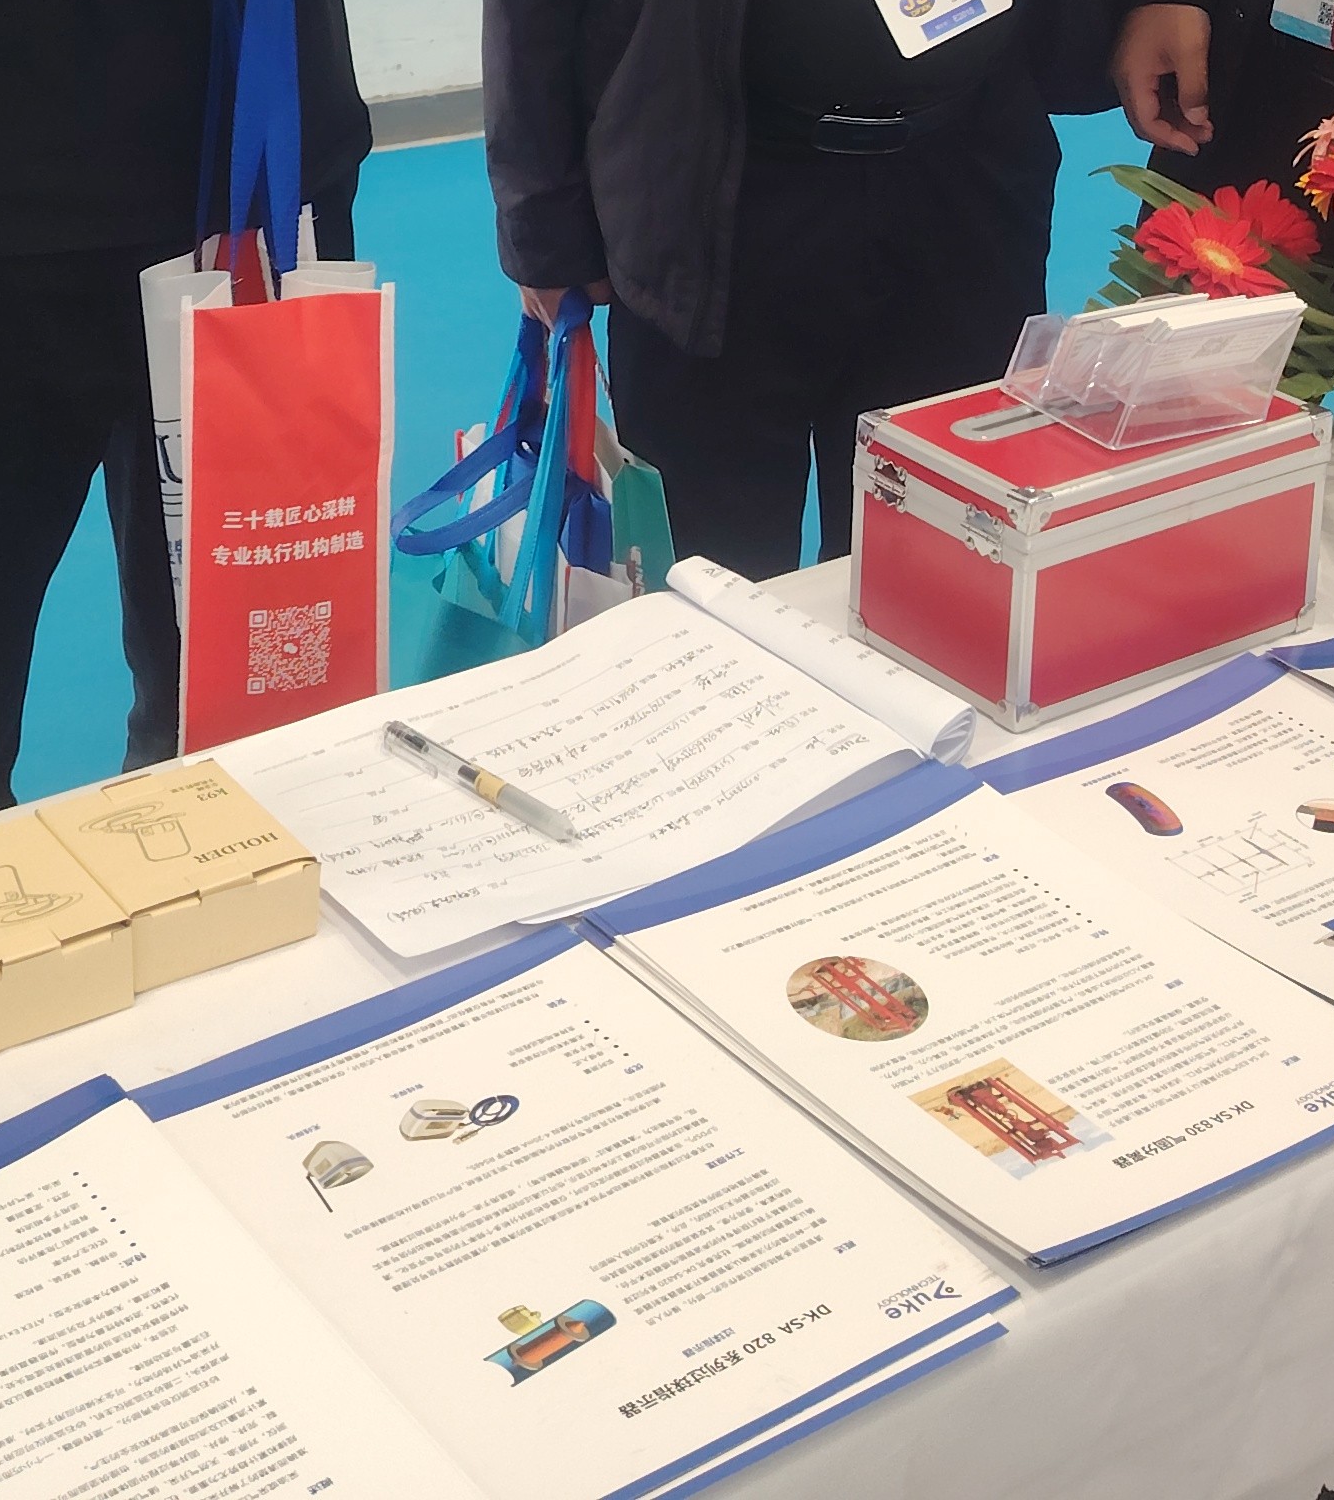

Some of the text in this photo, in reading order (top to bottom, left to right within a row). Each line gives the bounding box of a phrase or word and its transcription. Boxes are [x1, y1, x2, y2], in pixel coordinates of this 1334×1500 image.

[221, 496, 356, 531] 三十载匠心深耕
[210, 530, 365, 567] 专业执行机构制造
[195, 786, 229, 801] k93
[191, 831, 279, 864] HOLDER
[1109, 1100, 1256, 1169] DK SA 830 气固分离器
[704, 1147, 745, 1169] 工作原理
[832, 1239, 857, 1254] 概述
[873, 1272, 941, 1310] TECHNOLOGY
[679, 1326, 736, 1358] 过球指示器
[615, 1302, 833, 1420] DK-SA 820 系列过球指示器
[305, 1476, 334, 1495] 概述
